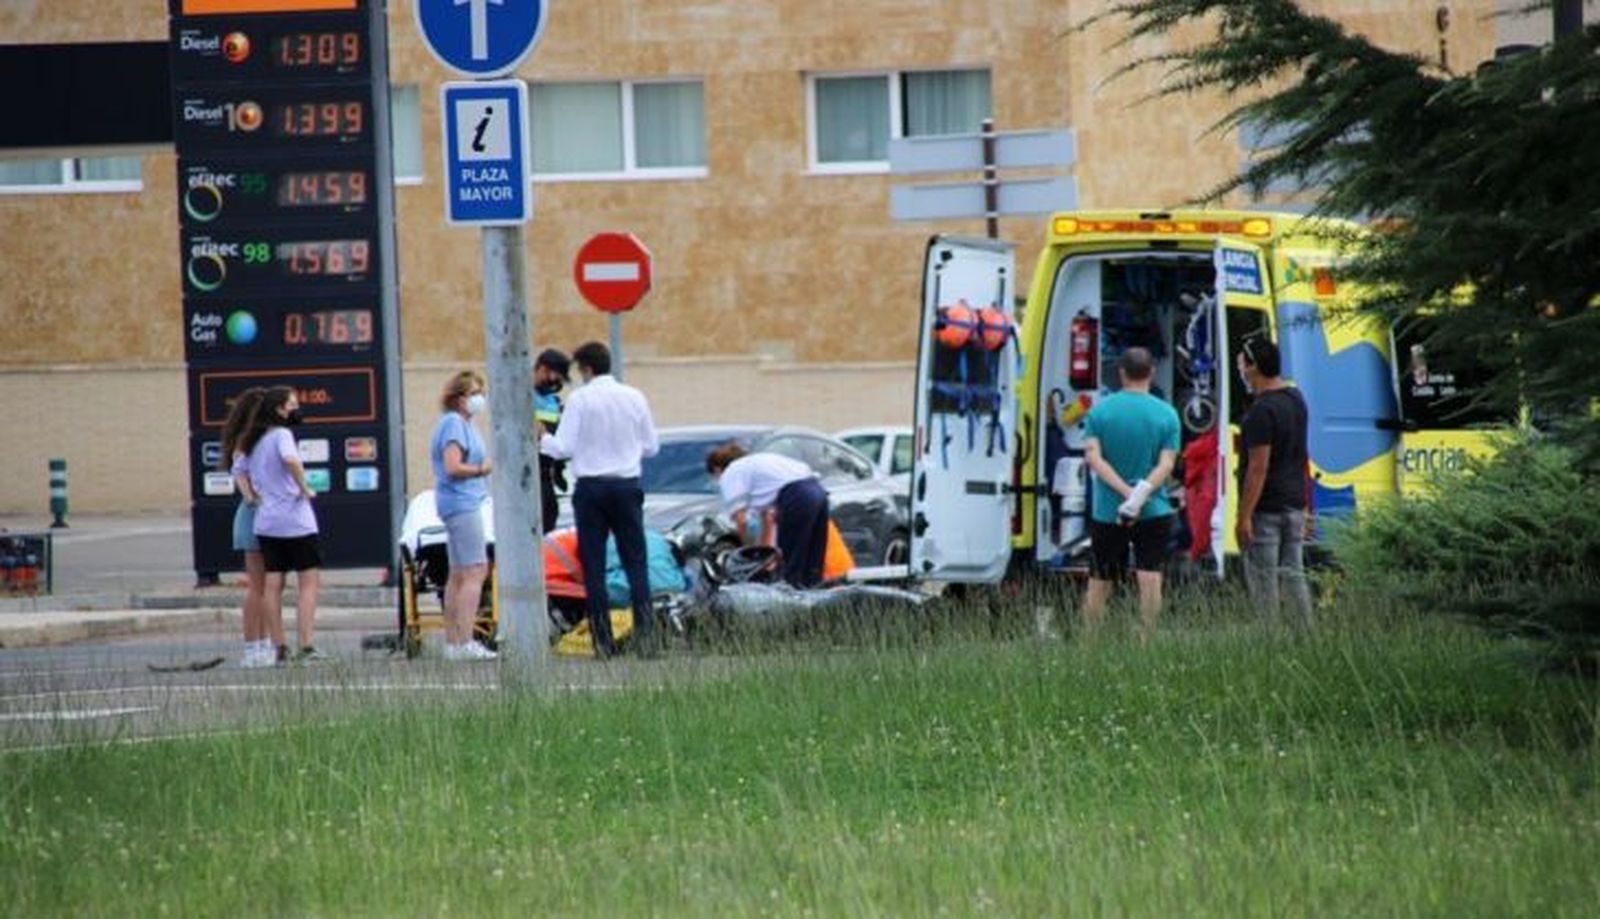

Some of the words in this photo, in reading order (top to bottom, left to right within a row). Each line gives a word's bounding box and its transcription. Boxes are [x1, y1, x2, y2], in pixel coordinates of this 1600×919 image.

[181, 35, 219, 50] Diesel
[281, 33, 359, 66] 1.309
[184, 104, 223, 120] Diesel
[284, 103, 362, 135] 1.399
[462, 168, 509, 183] PLAZA
[288, 171, 366, 205] 1.459
[460, 187, 513, 202] MAYOR
[242, 243, 270, 263] 98
[289, 241, 369, 274] 1.569
[191, 312, 223, 326] Auto
[191, 328, 217, 342] Gas
[1401, 443, 1466, 472] encias
